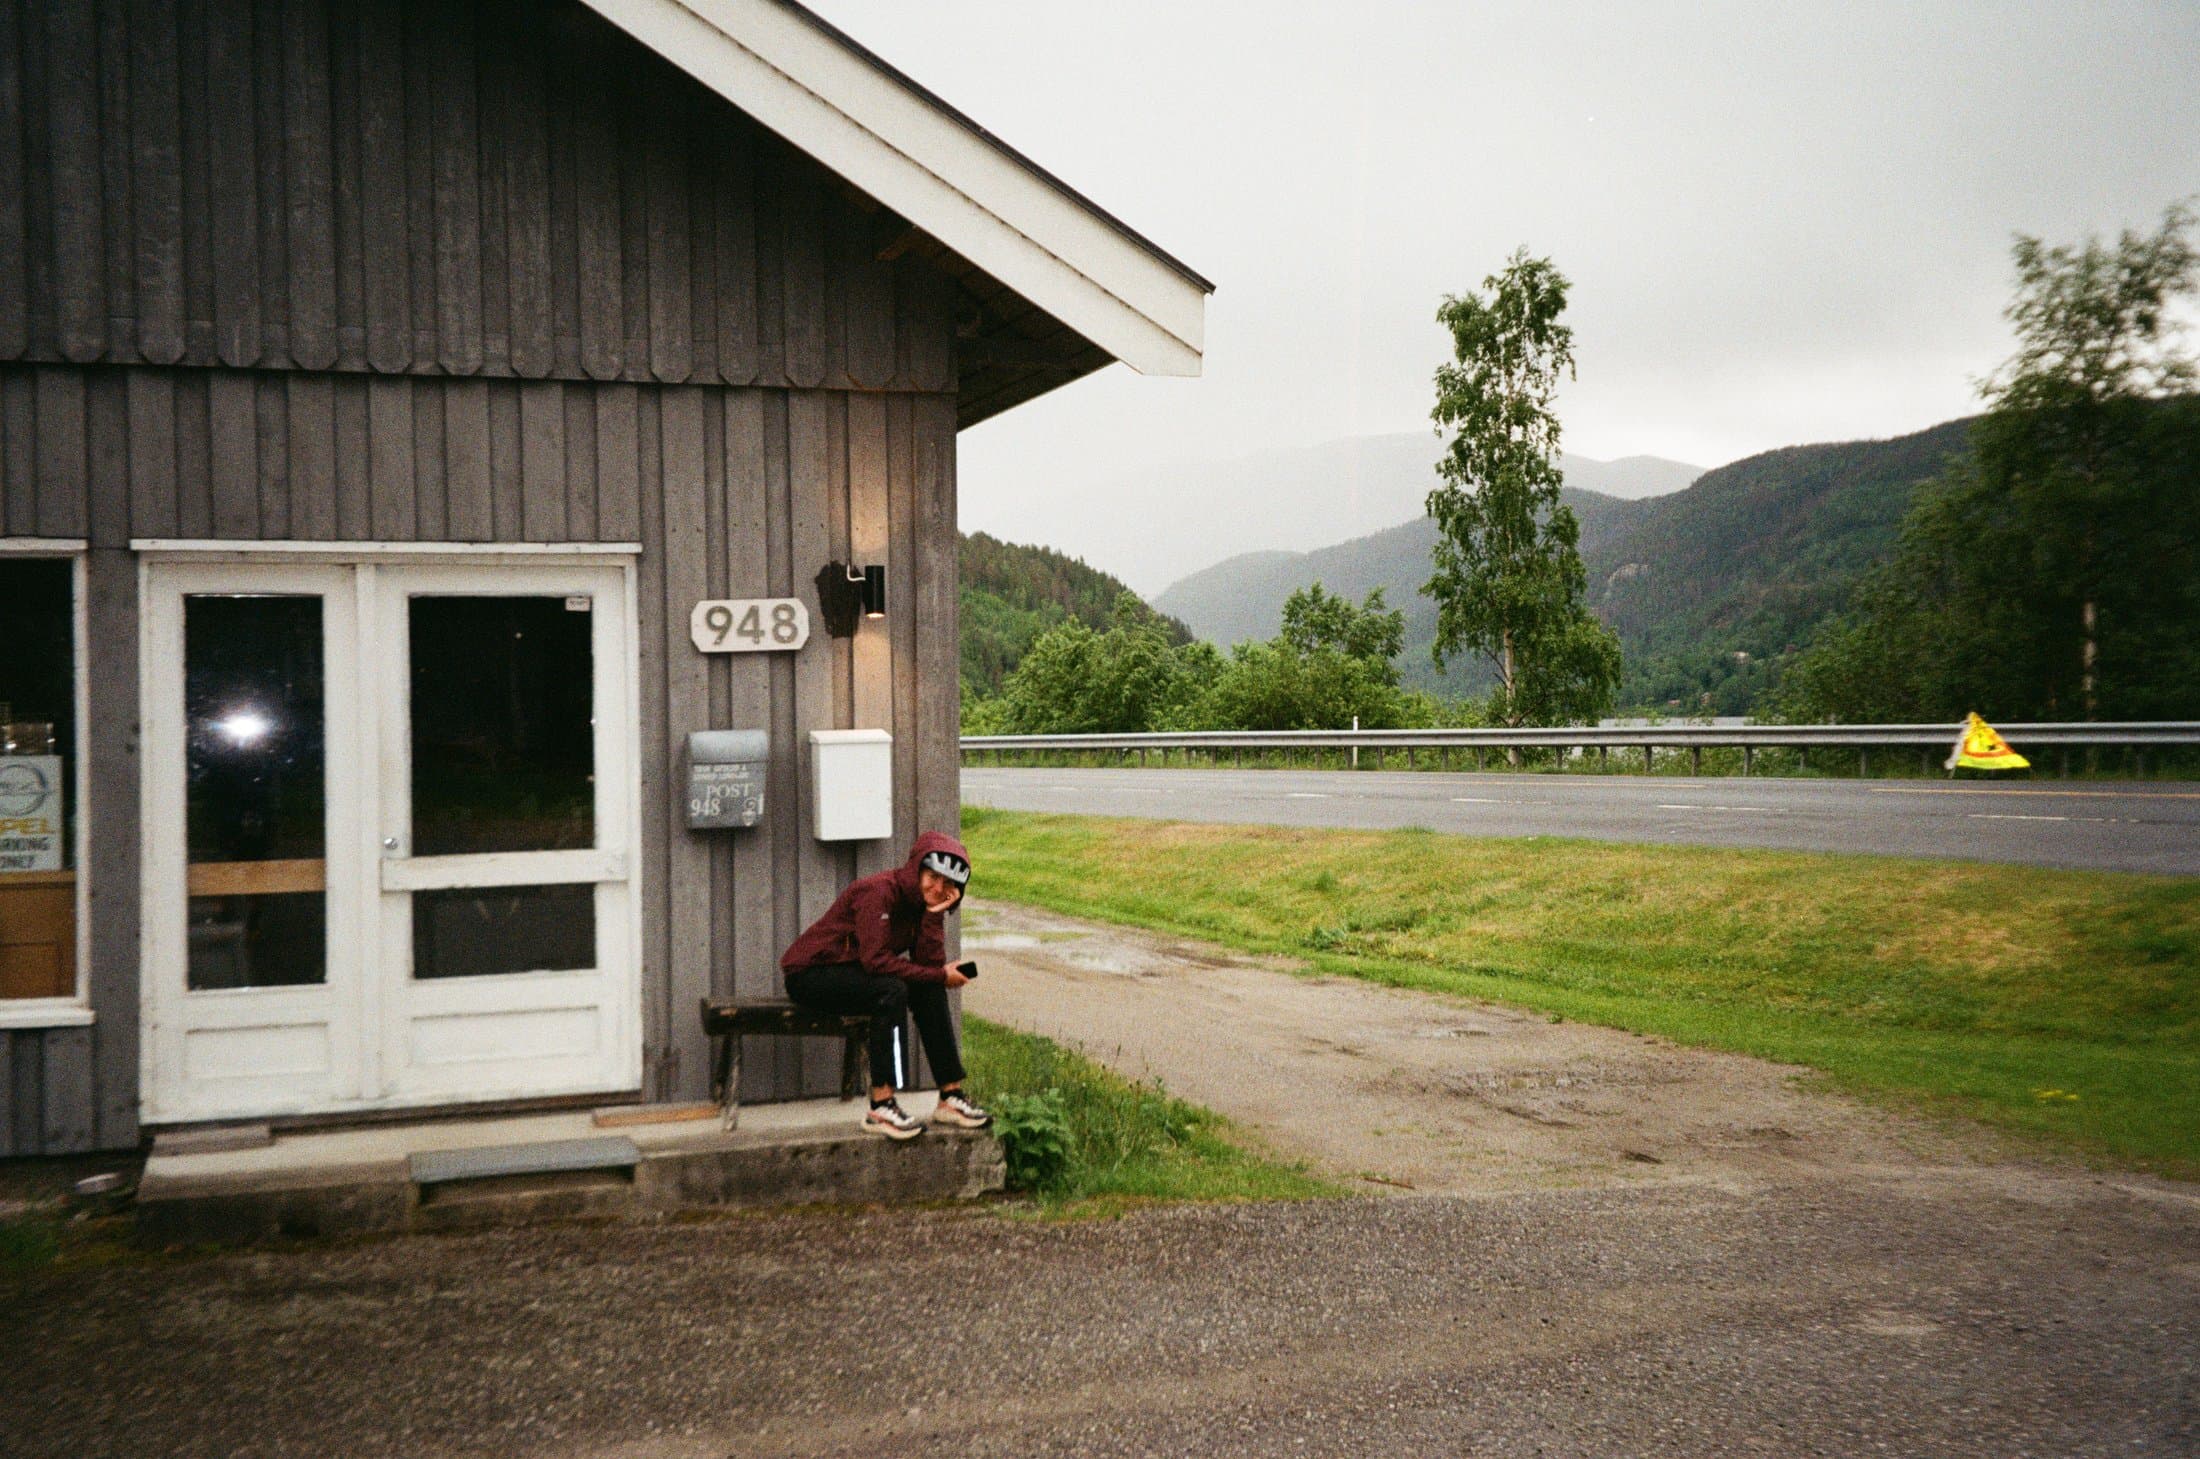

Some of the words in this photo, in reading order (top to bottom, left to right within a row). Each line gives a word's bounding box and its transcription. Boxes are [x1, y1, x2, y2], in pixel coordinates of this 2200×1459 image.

[705, 603, 798, 645] 948
[707, 783, 755, 798] POST
[691, 799, 720, 816] 948
